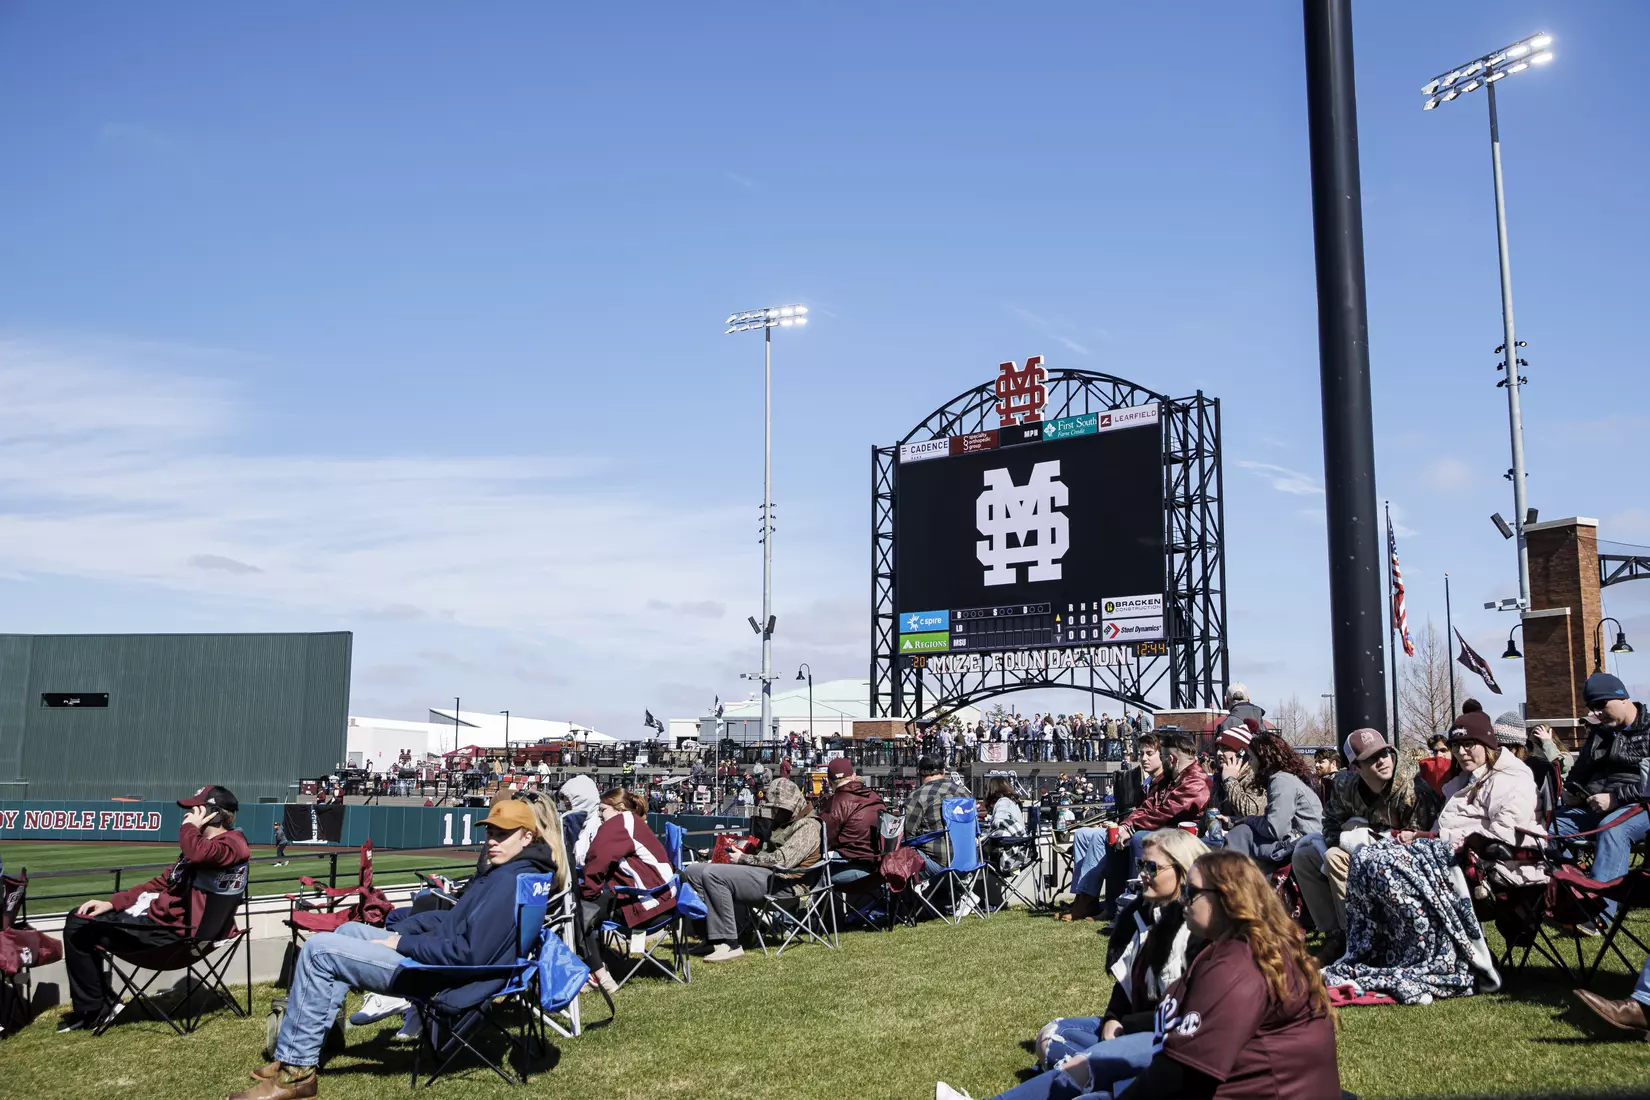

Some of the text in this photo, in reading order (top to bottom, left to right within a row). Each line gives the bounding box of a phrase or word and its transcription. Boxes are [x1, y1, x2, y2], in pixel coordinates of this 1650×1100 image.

[1114, 409, 1157, 423] LEARFIELD
[1058, 416, 1097, 431] First South
[1023, 429, 1039, 438] MPH
[910, 440, 949, 454] CADENCE
[1068, 601, 1098, 612] R H E
[1115, 598, 1161, 608] BRACKEN
[956, 611, 962, 619] B
[993, 608, 998, 617] S
[1115, 605, 1162, 613] CONSTRUCTION
[1068, 613, 1098, 626] 0 0 0
[955, 624, 963, 633] LB
[1056, 623, 1061, 634] 1
[1120, 626, 1135, 634] Steel
[1068, 628, 1099, 641] 0 0 0
[953, 638, 967, 648] MSU
[1136, 642, 1166, 657] 12:44
[932, 653, 982, 675] MIZE
[0, 810, 162, 831] Y NOBLE FIELD
